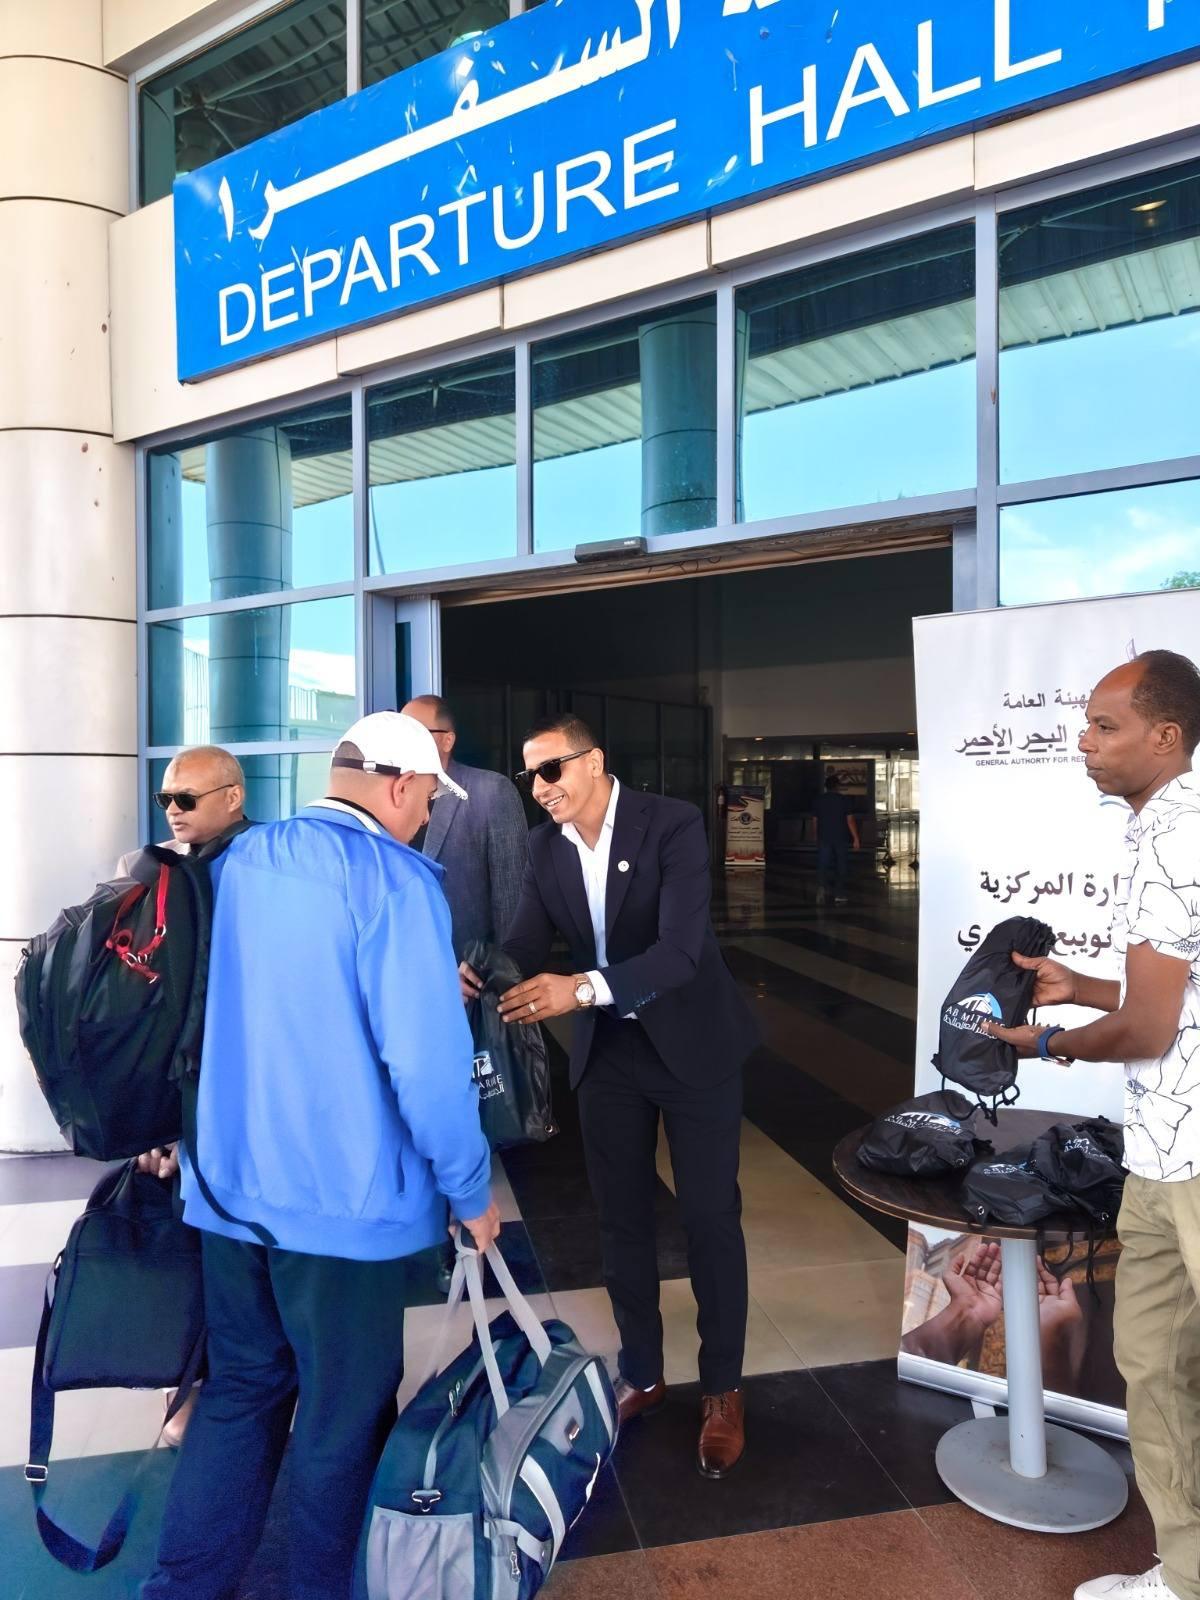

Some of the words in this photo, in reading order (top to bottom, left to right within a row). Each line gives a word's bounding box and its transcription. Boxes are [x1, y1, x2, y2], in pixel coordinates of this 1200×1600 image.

[218, 118, 681, 346] DEPARTURE
[749, 0, 1062, 166] HALL
[1002, 691, 1046, 709] العامة
[954, 721, 1013, 753] الأحمر
[1016, 723, 1068, 752] البحر
[975, 758, 1009, 767] GENERAL
[1053, 756, 1069, 764] FOR
[979, 870, 1074, 904] المركزية
